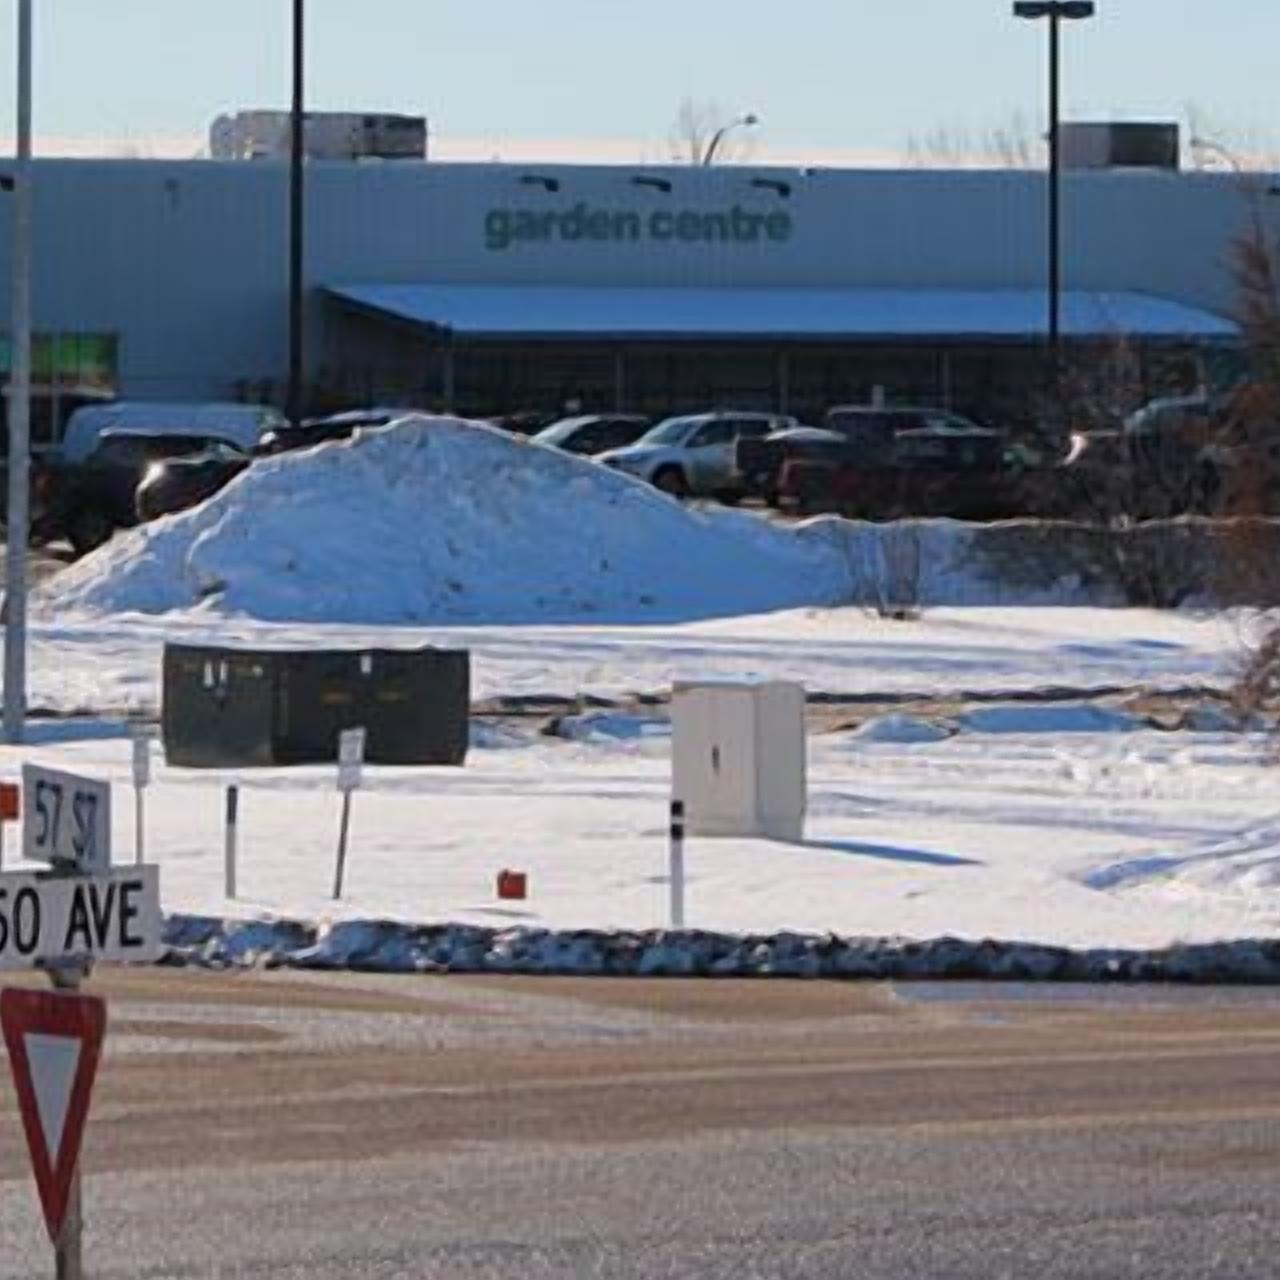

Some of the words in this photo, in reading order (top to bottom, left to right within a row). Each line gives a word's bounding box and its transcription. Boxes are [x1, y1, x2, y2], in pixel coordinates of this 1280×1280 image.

[485, 202, 640, 251] garden
[648, 203, 793, 243] centre
[35, 780, 62, 850] 57
[72, 791, 97, 861] ST
[63, 880, 144, 953] AVE
